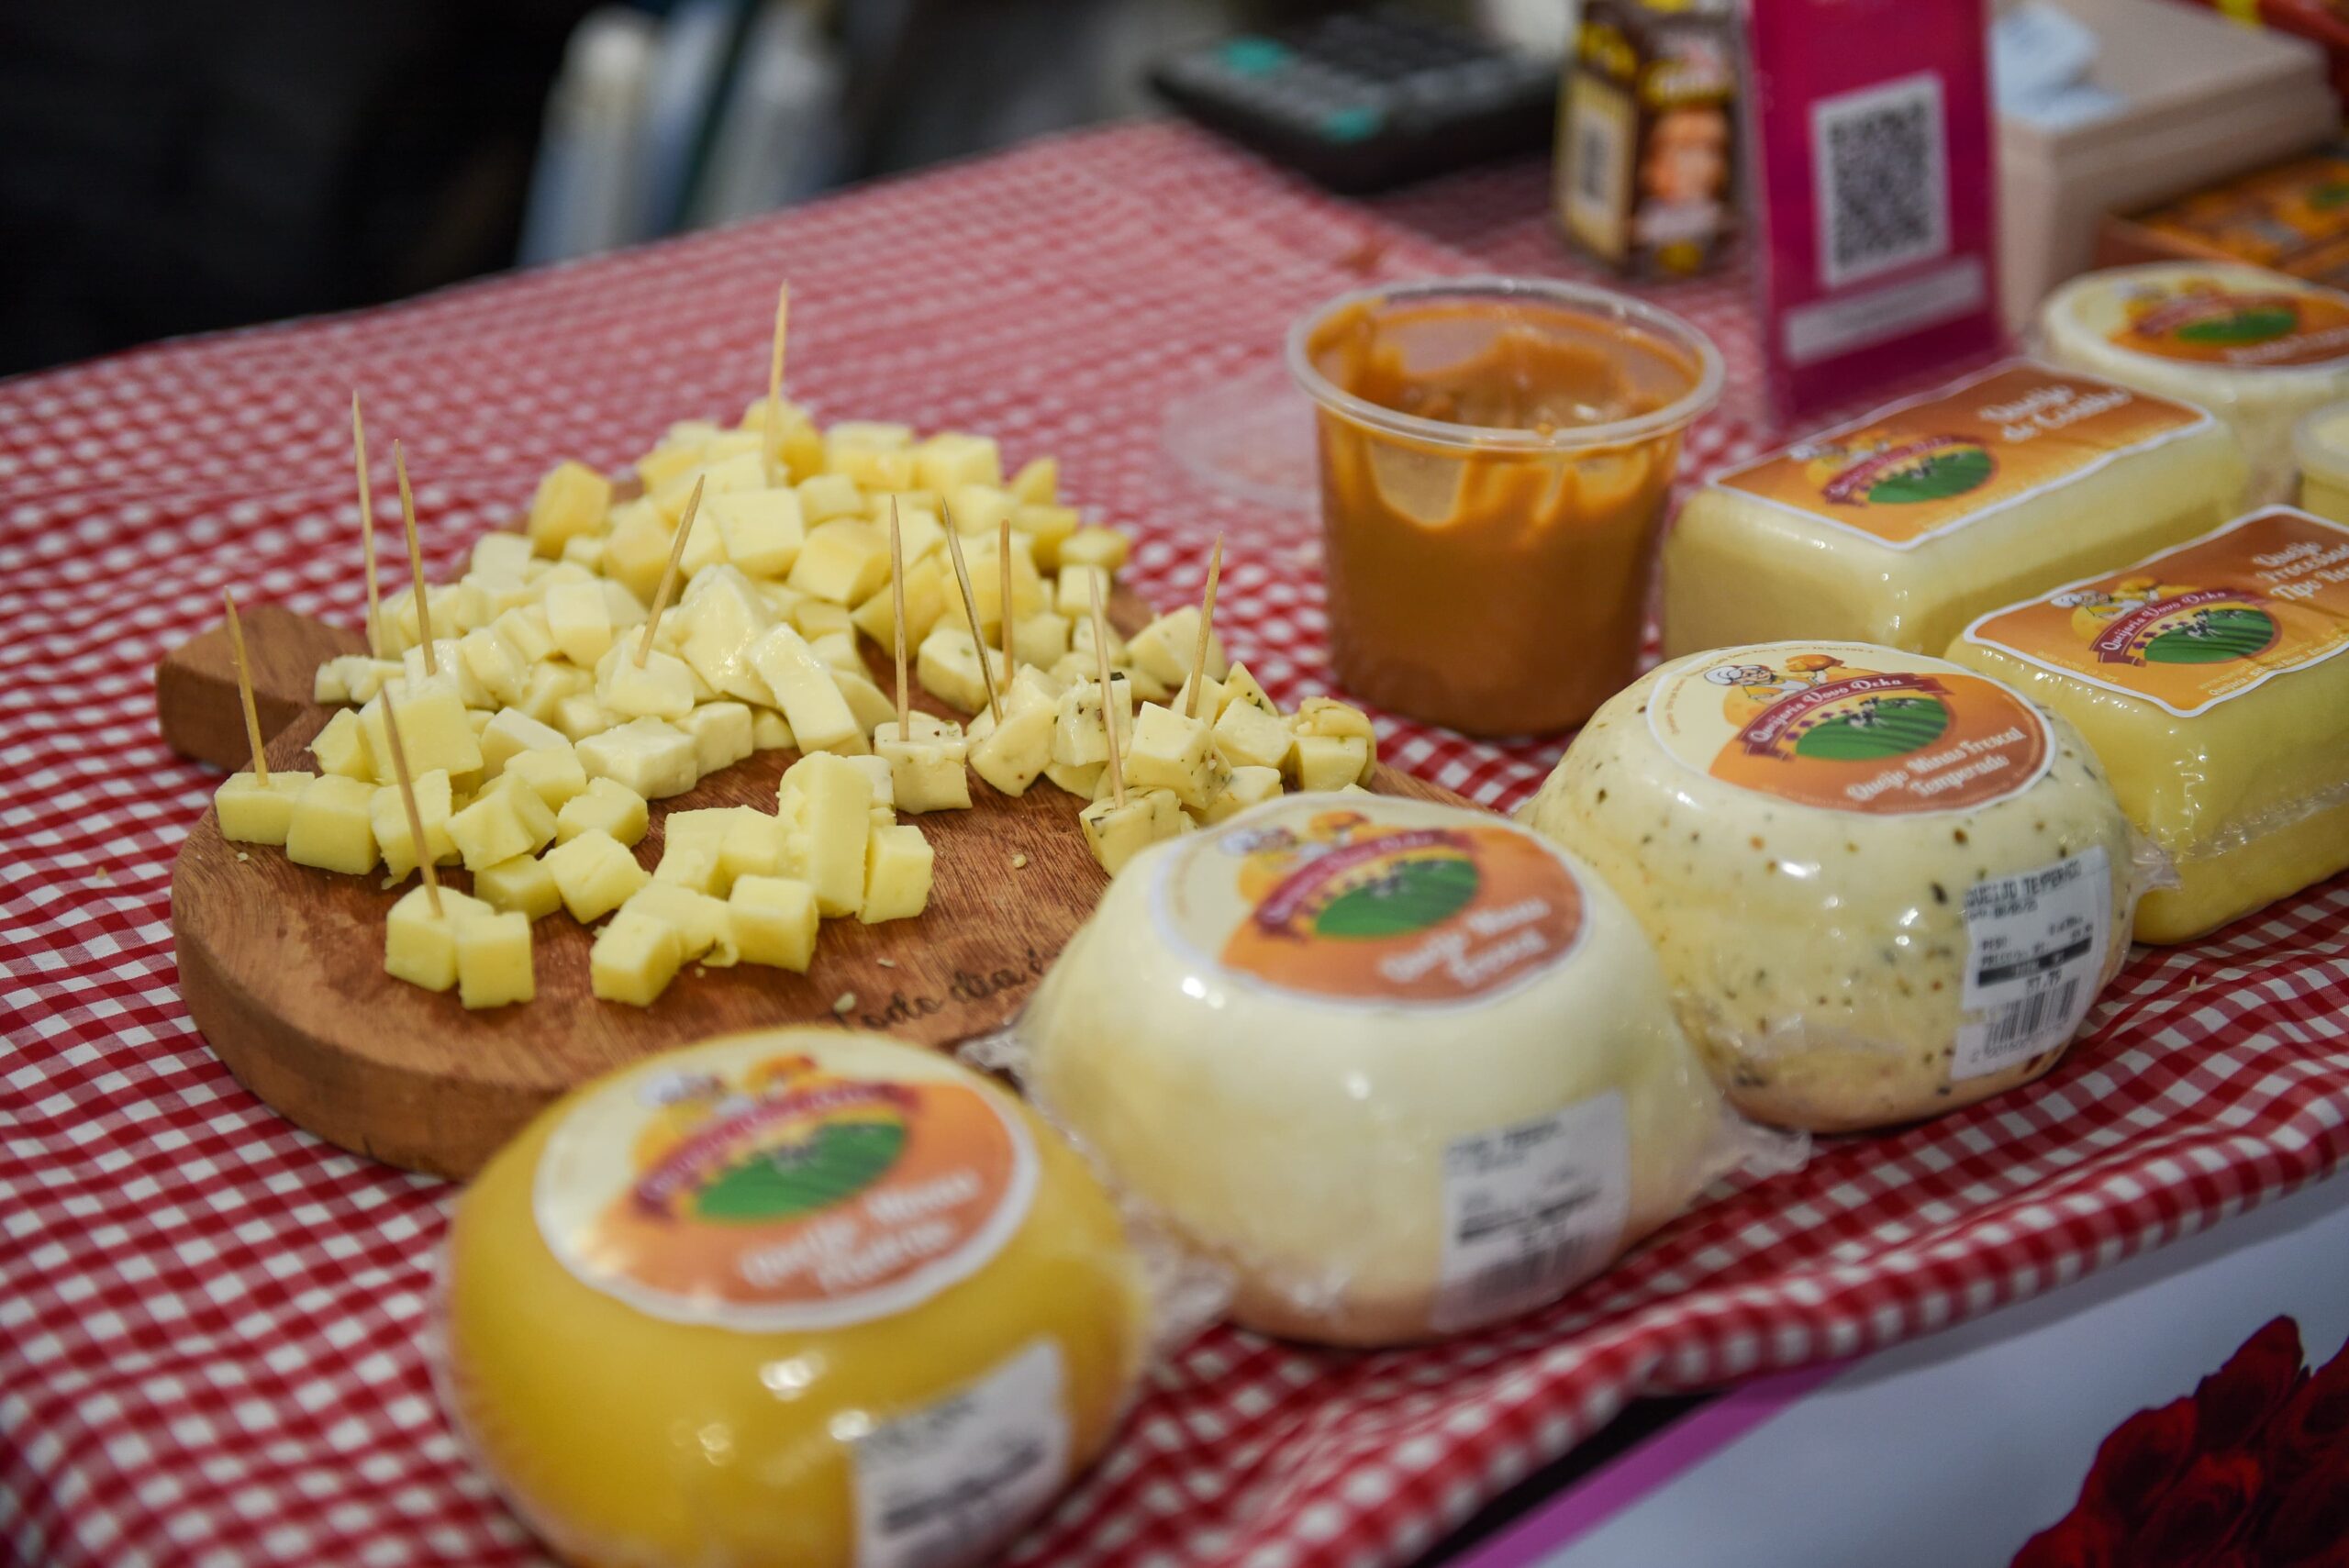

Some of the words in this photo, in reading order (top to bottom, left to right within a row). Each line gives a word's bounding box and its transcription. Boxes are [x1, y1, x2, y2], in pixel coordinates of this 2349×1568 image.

[2253, 542, 2321, 567] Queijo
[2100, 617, 2146, 651] Queijaria
[1748, 703, 1807, 743] Queijaria
[1846, 771, 1909, 801] Queijo
[1907, 748, 1967, 773] Minas
[1909, 754, 2009, 797] Temperado
